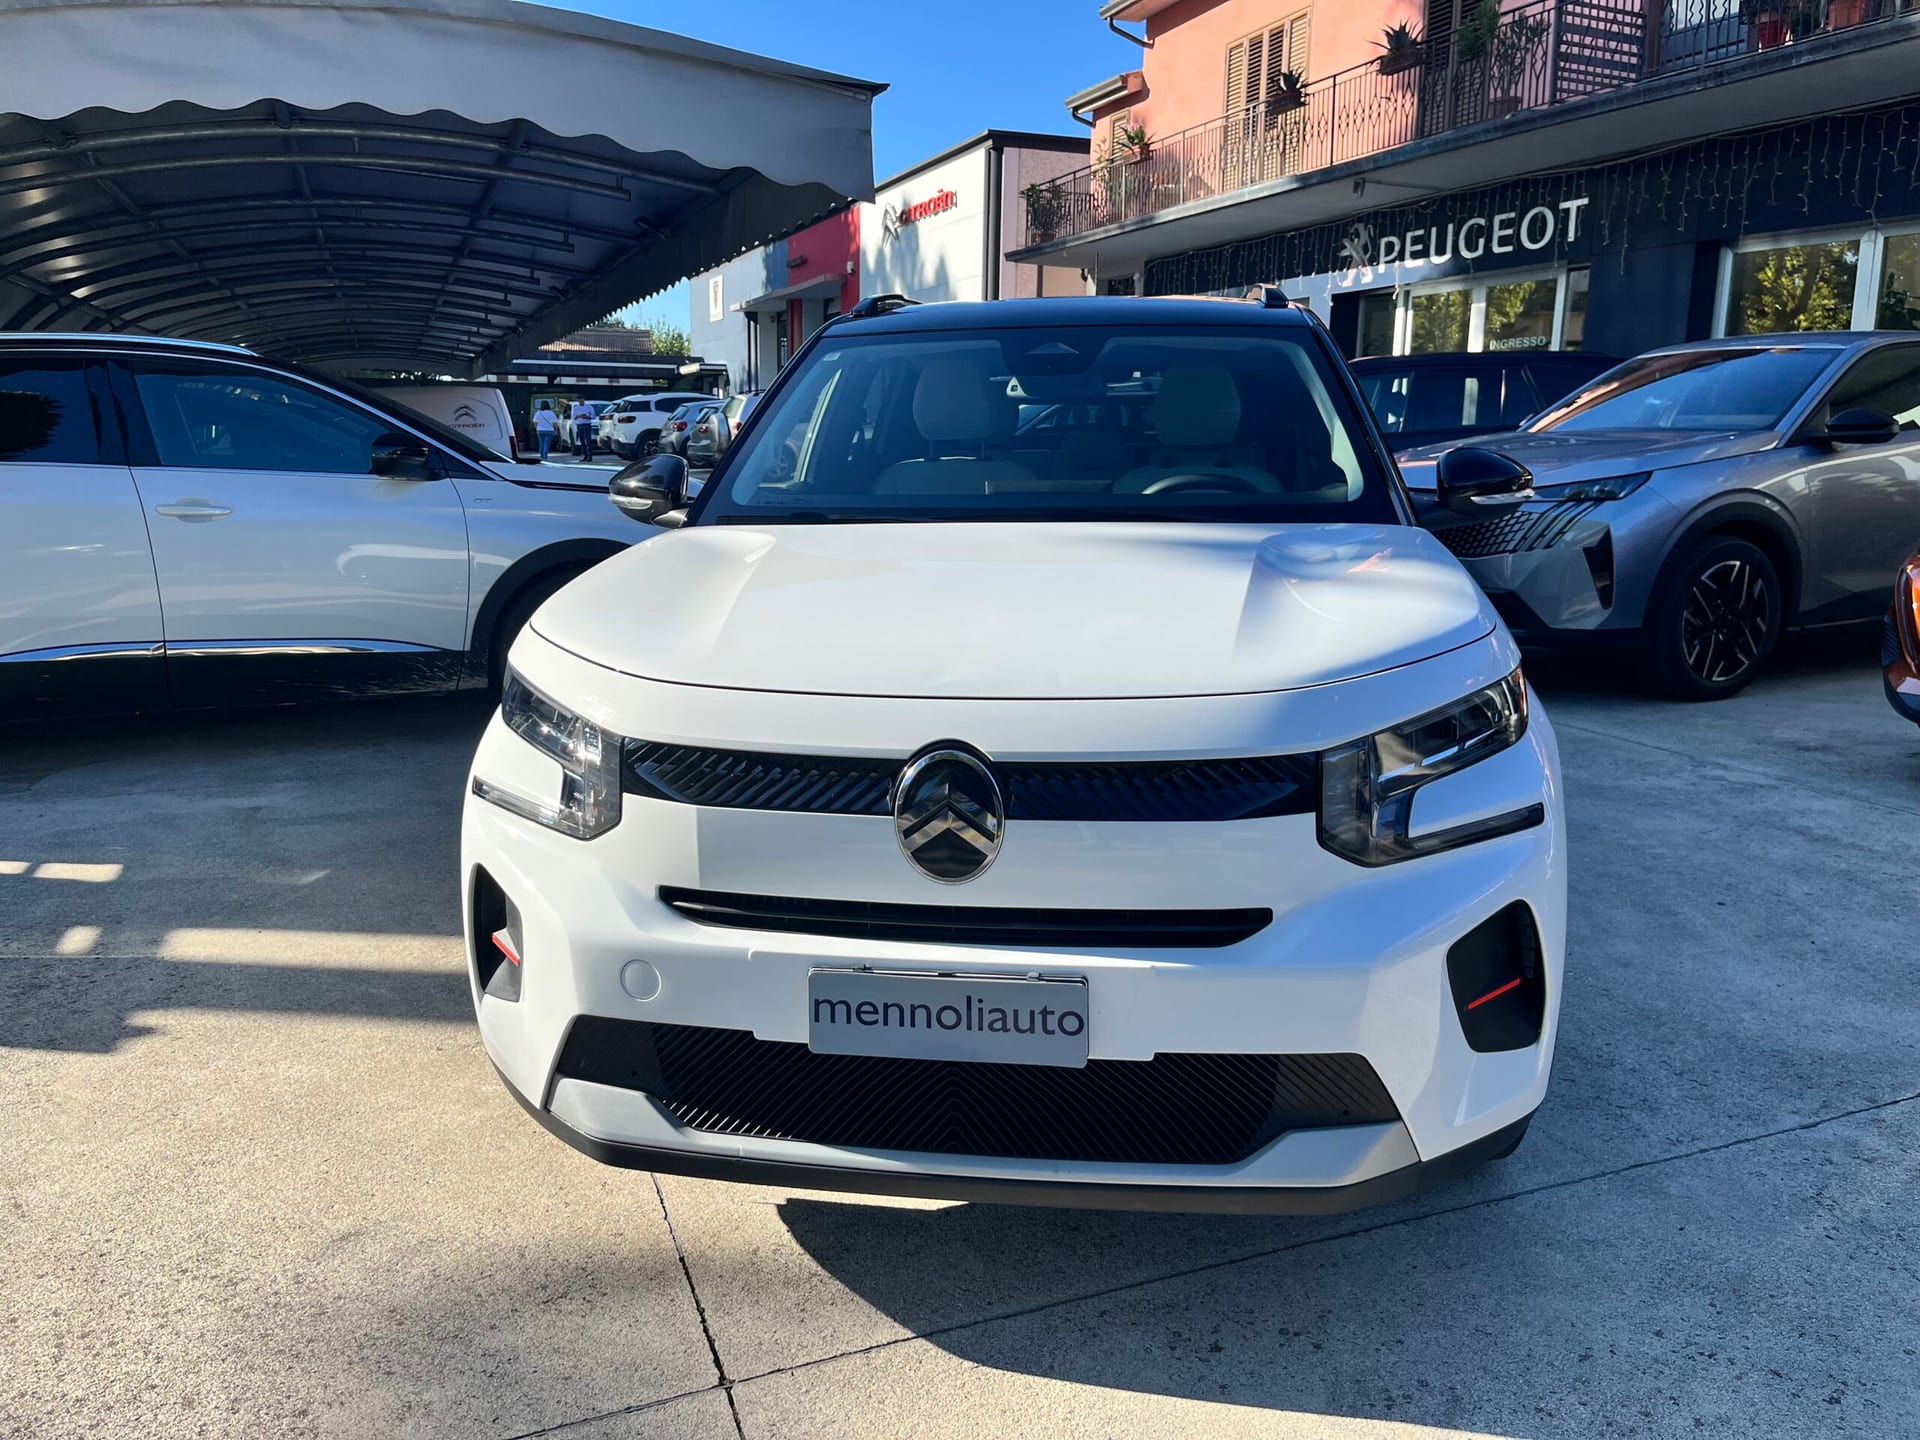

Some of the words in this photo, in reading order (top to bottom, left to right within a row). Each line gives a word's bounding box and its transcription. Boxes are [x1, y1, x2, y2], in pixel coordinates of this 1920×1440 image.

[1378, 198, 1590, 273] PEUGEOT
[1490, 336, 1546, 350] INGRESSO
[814, 995, 1085, 1037] mennoliauto
